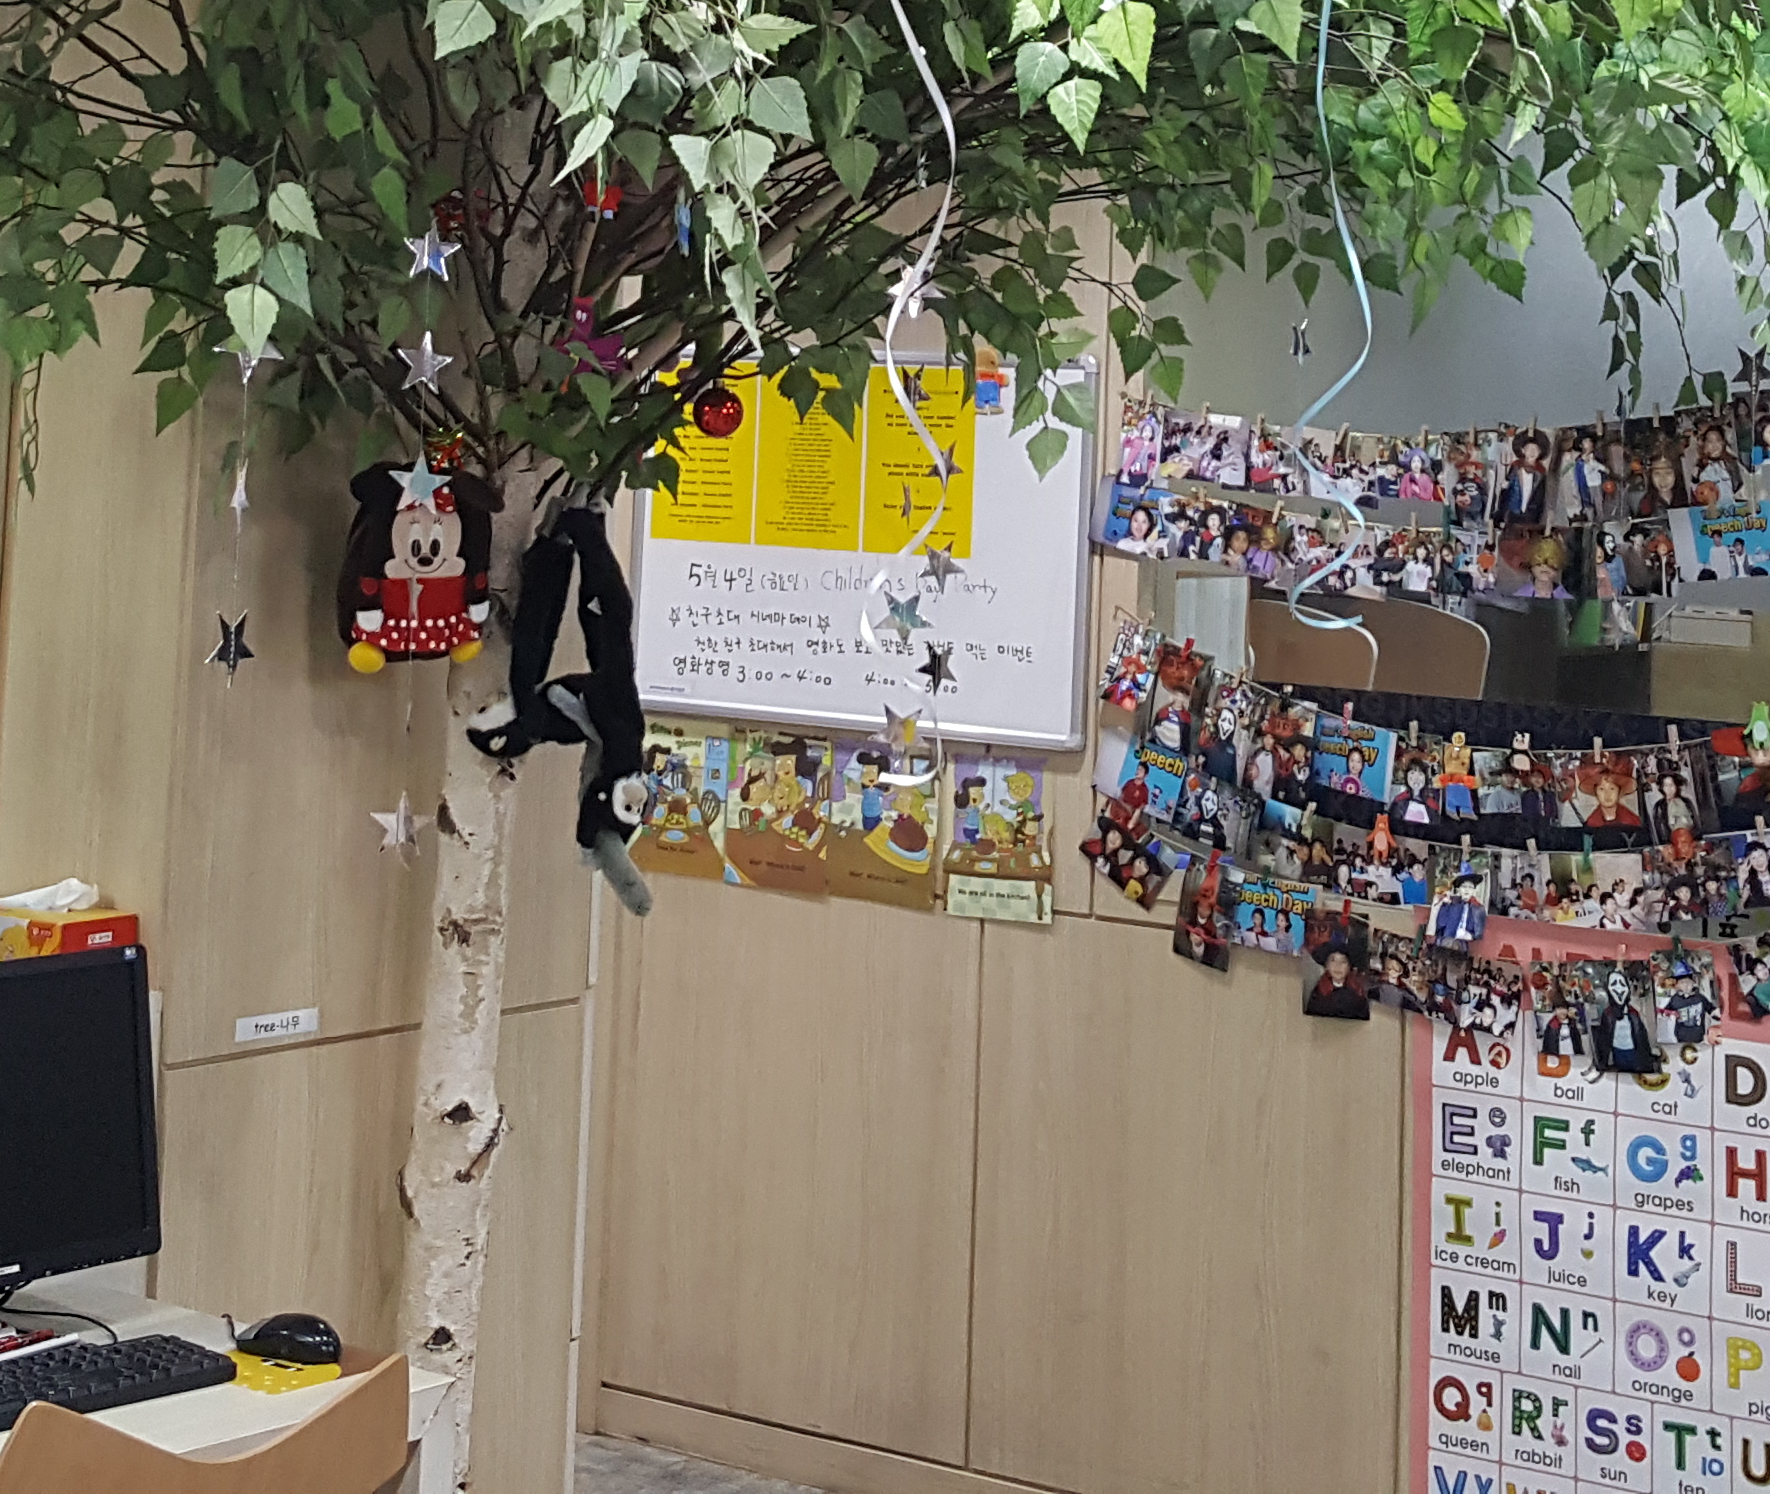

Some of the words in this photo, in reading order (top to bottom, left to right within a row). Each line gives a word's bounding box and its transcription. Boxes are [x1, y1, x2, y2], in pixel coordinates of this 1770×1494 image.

[688, 562, 718, 589] 5월
[723, 566, 755, 593] 4일
[806, 638, 846, 656] 영화도
[672, 656, 730, 677] 영화상영
[736, 666, 774, 684] 3:00
[796, 669, 832, 686] 4:00
[864, 671, 896, 687] 4:00
[1452, 1070, 1500, 1090] apple
[1553, 1083, 1585, 1102] ball
[1724, 1053, 1768, 1108] D
[1650, 1099, 1679, 1117] cat
[1441, 1102, 1479, 1156] E
[1488, 1106, 1508, 1129] e
[1532, 1114, 1571, 1167] F
[1580, 1118, 1597, 1148] f
[1440, 1157, 1512, 1183] elephant
[1626, 1134, 1669, 1184] G
[1679, 1134, 1698, 1163] g
[1725, 1145, 1769, 1203] H
[1553, 1175, 1581, 1195] fish
[1634, 1191, 1695, 1213] grapes
[1443, 1192, 1476, 1248] I
[1493, 1200, 1503, 1228] i
[1532, 1209, 1565, 1262] J
[1582, 1210, 1596, 1241] j
[1434, 1244, 1460, 1264] ice
[1464, 1253, 1518, 1276] cream
[1627, 1224, 1669, 1284] K
[1678, 1230, 1697, 1263] k
[1726, 1239, 1764, 1298] L
[1547, 1265, 1588, 1288] juice
[1440, 1284, 1481, 1340] M
[1487, 1289, 1509, 1314] m
[1647, 1284, 1679, 1308] key
[1529, 1302, 1573, 1357] N
[1581, 1309, 1600, 1334] n
[1447, 1342, 1502, 1365] mouse
[1625, 1319, 1670, 1374] O
[1676, 1325, 1697, 1349] o
[1552, 1363, 1583, 1381] nail
[1726, 1336, 1765, 1391] P
[1433, 1375, 1473, 1423] Q
[1475, 1381, 1494, 1409] q
[1631, 1378, 1694, 1404] orange
[1511, 1388, 1546, 1442] R
[1550, 1395, 1570, 1419] r
[1583, 1406, 1621, 1456] S
[1624, 1413, 1644, 1437] s
[1438, 1432, 1491, 1455] queen
[1514, 1448, 1565, 1470] rabbit
[1662, 1419, 1699, 1472] T
[1704, 1426, 1724, 1452] t
[1599, 1465, 1629, 1484] sun
